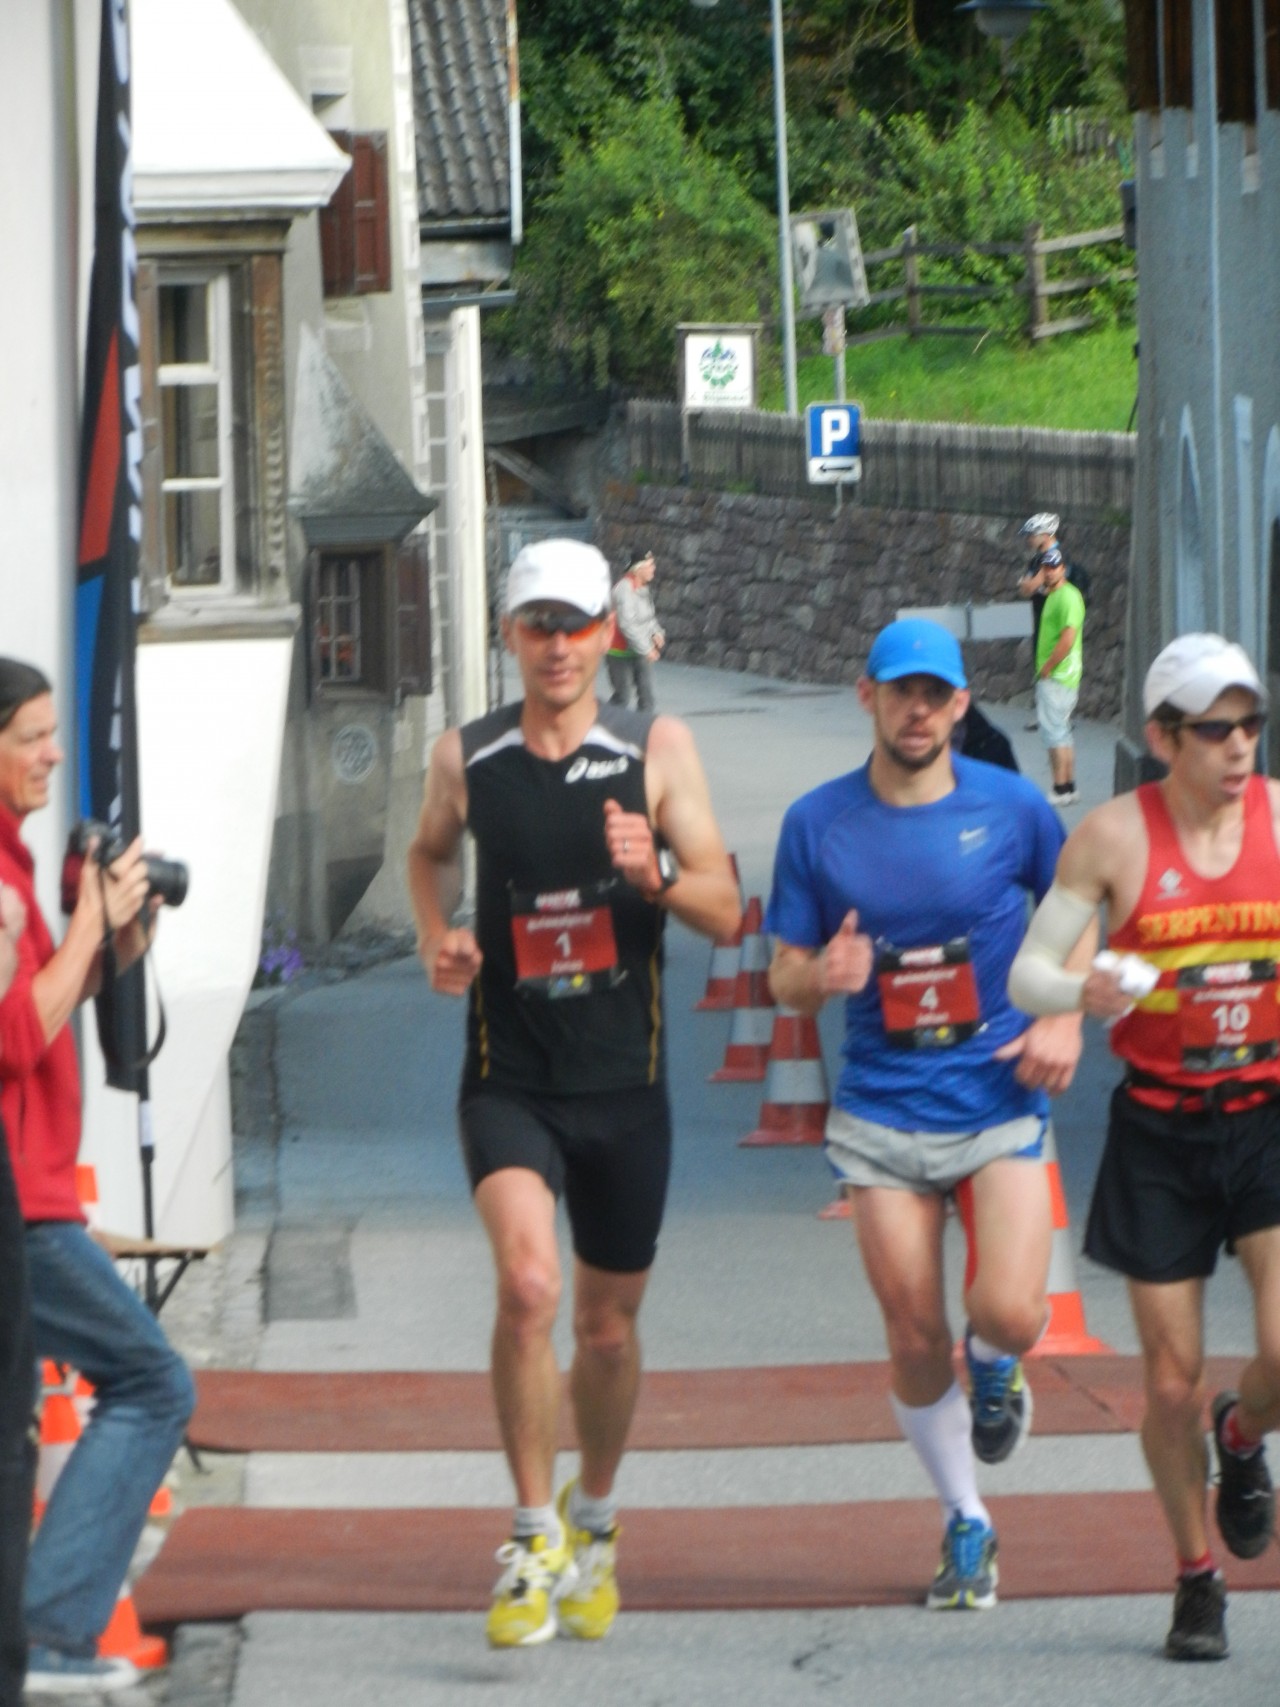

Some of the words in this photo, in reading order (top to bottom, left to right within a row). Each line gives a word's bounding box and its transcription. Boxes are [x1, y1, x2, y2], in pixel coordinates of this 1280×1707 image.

[821, 409, 851, 456] P
[555, 931, 571, 958] 1
[919, 985, 939, 1012] 4
[1211, 1003, 1250, 1032] 10
